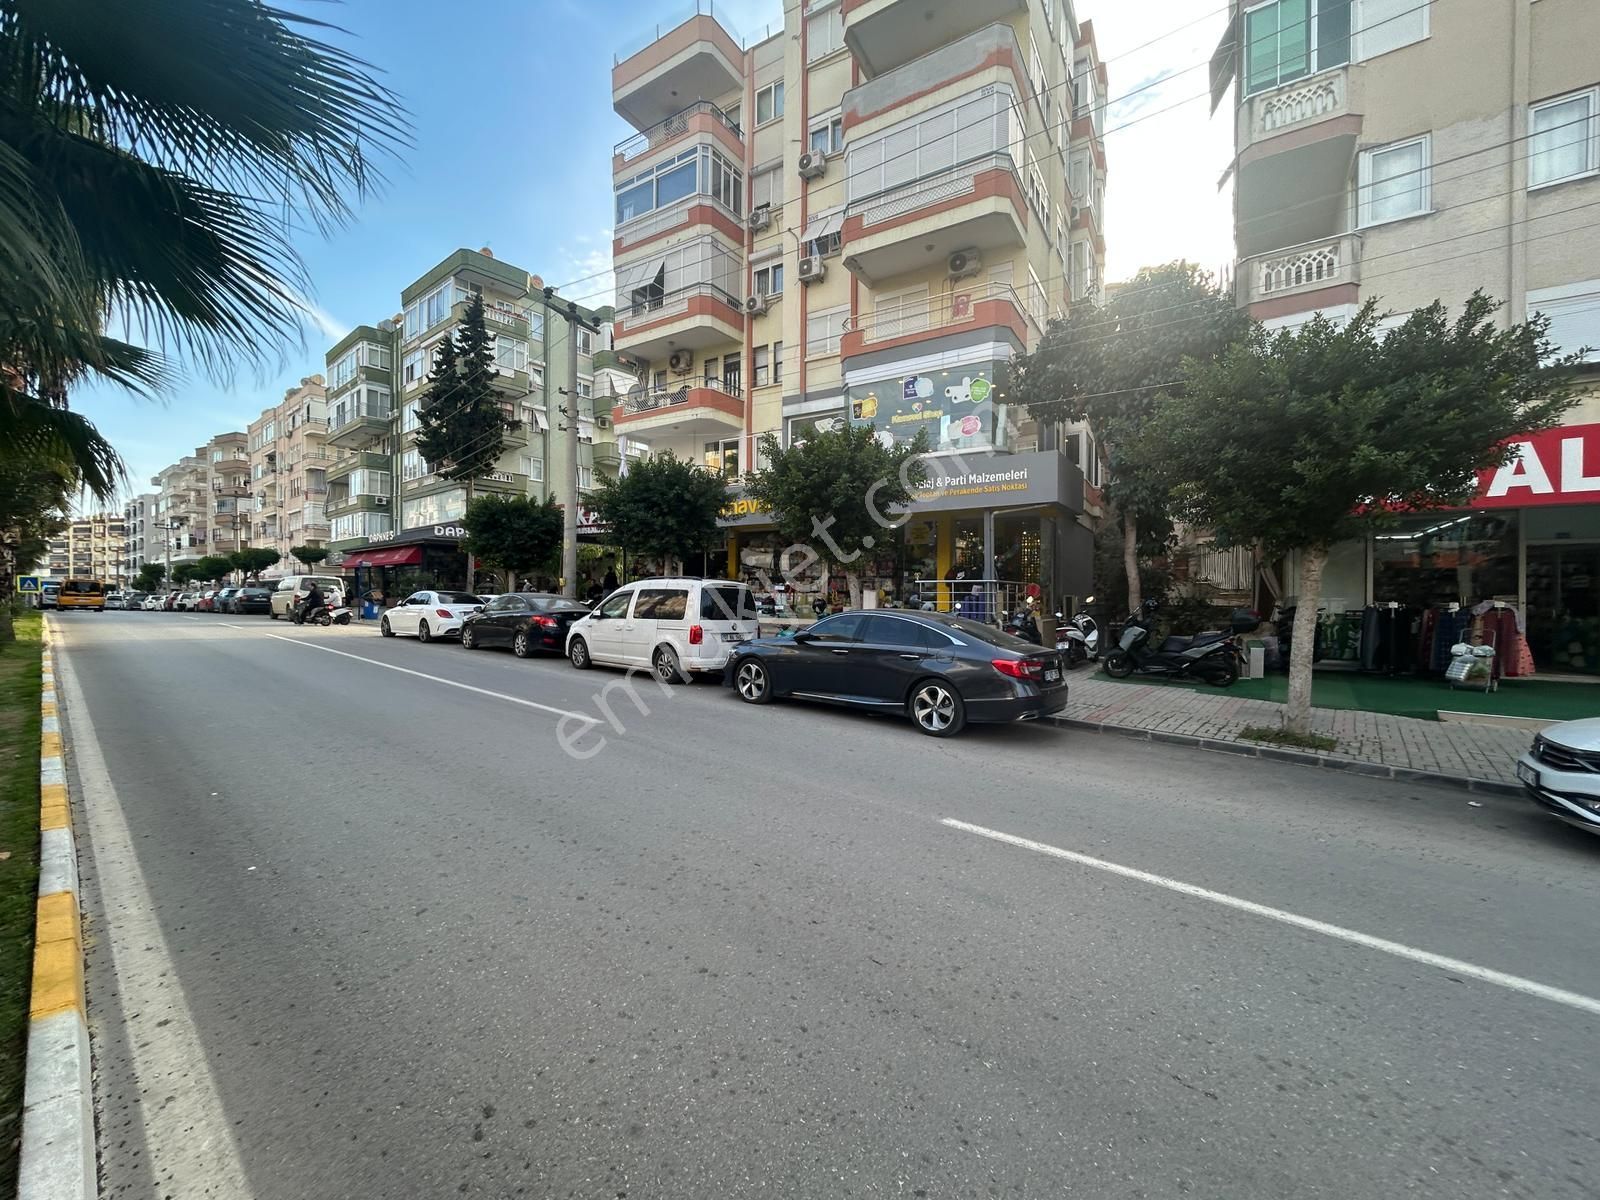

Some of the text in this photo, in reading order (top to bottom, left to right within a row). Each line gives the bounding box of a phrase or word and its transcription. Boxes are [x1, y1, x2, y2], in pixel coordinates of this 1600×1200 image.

[936, 477, 943, 487] &
[945, 474, 967, 487] Parti
[969, 468, 1028, 485] Malzemeleri
